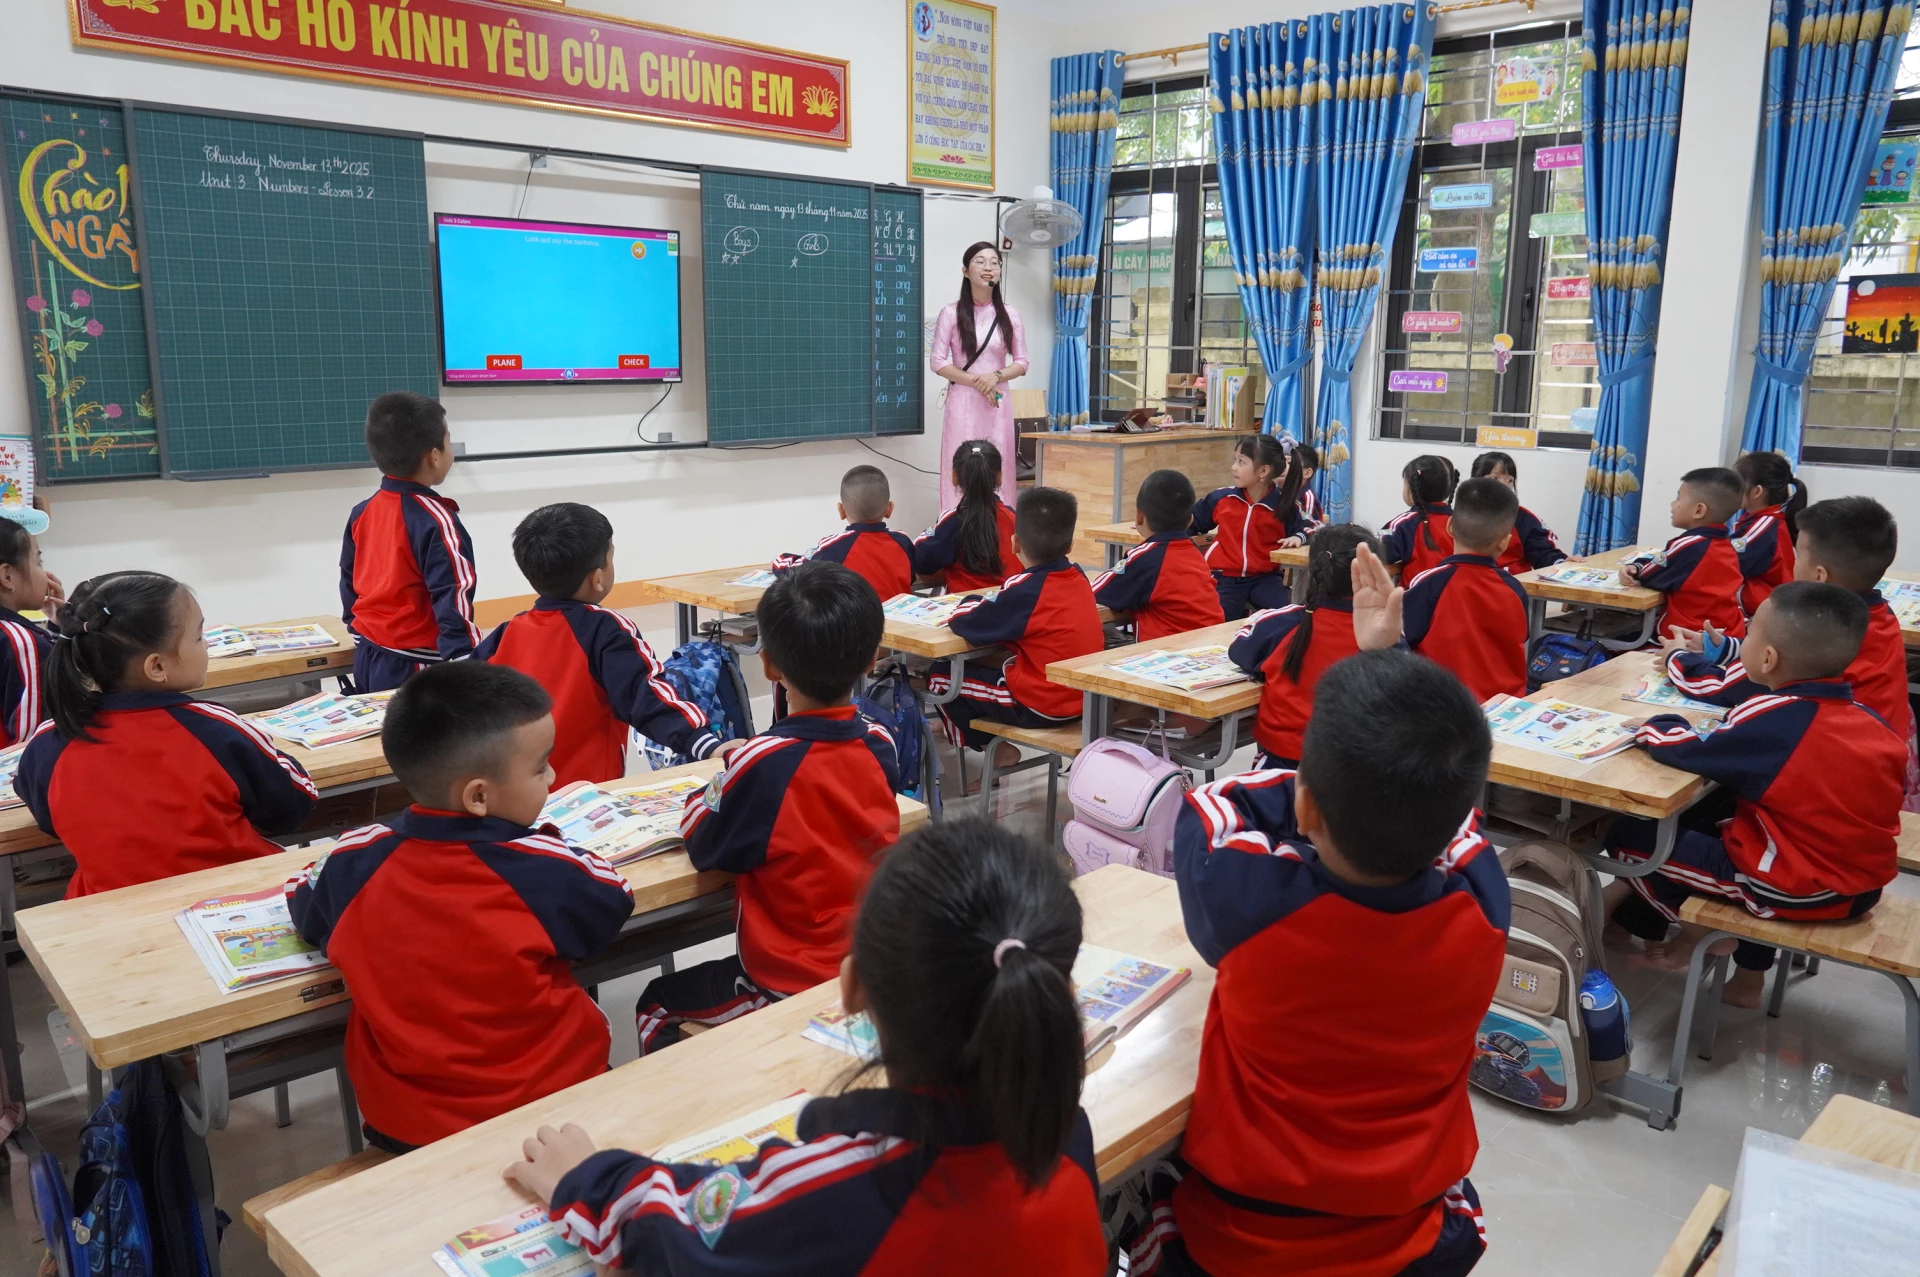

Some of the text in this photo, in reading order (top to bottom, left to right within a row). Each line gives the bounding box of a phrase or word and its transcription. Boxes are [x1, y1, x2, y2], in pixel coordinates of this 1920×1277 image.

[370, 0, 469, 70] KÍNH
[480, 18, 549, 81] YÊU
[561, 29, 629, 93] CỦA
[639, 51, 741, 109] CHÚNG
[752, 70, 793, 117] EM
[268, 154, 317, 172] November
[341, 160, 370, 176] 2025
[200, 170, 232, 189] Unit
[259, 176, 308, 194] Numbers
[318, 181, 354, 198] Lesson
[1124, 254, 1142, 270] CÂY
[493, 358, 516, 366] PLANE
[222, 900, 247, 908] BODY
